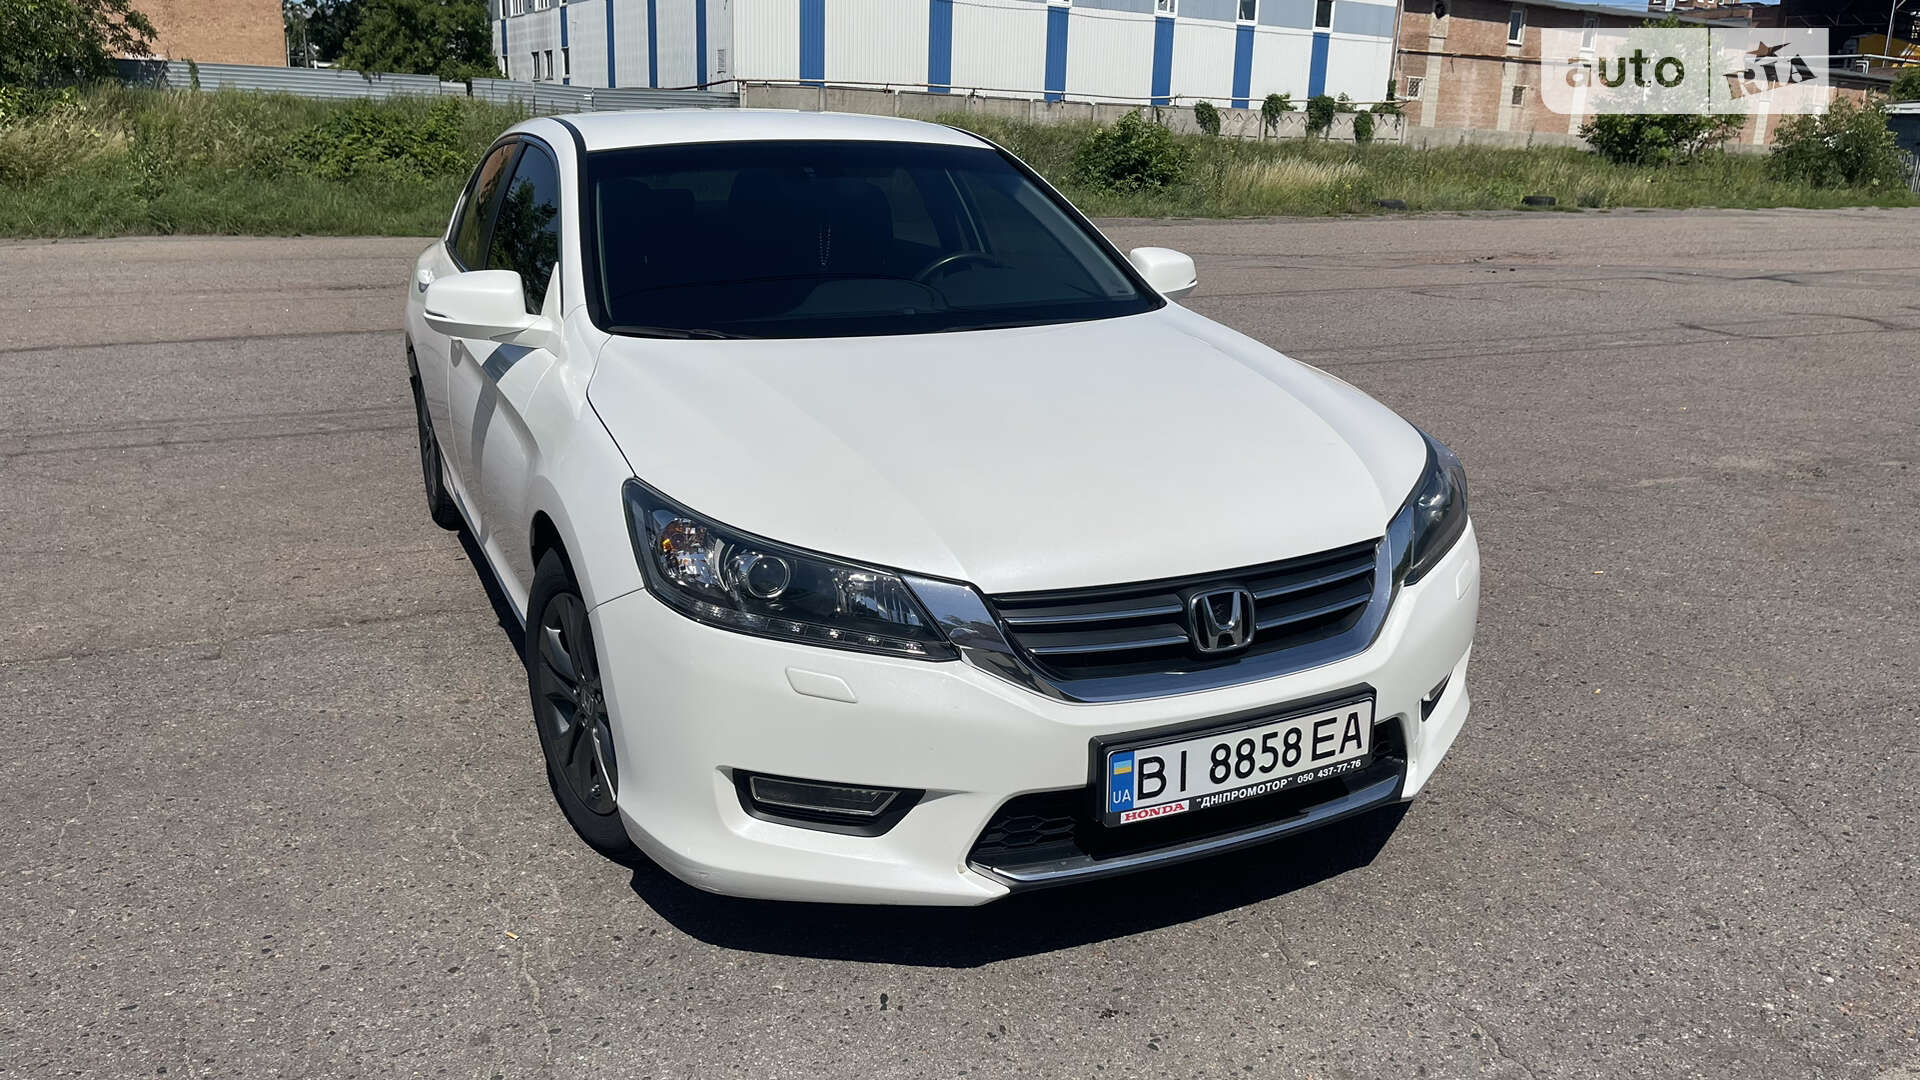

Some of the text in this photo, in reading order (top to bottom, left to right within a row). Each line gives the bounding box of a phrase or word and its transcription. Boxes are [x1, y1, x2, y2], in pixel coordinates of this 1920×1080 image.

[1209, 727, 1302, 784] 8858
[1311, 711, 1363, 762] EA
[1113, 789, 1131, 804] UA
[1196, 759, 1362, 808] "ДНІПРОМОТОР" 050 437-77-76
[1124, 802, 1185, 822] HONDA
